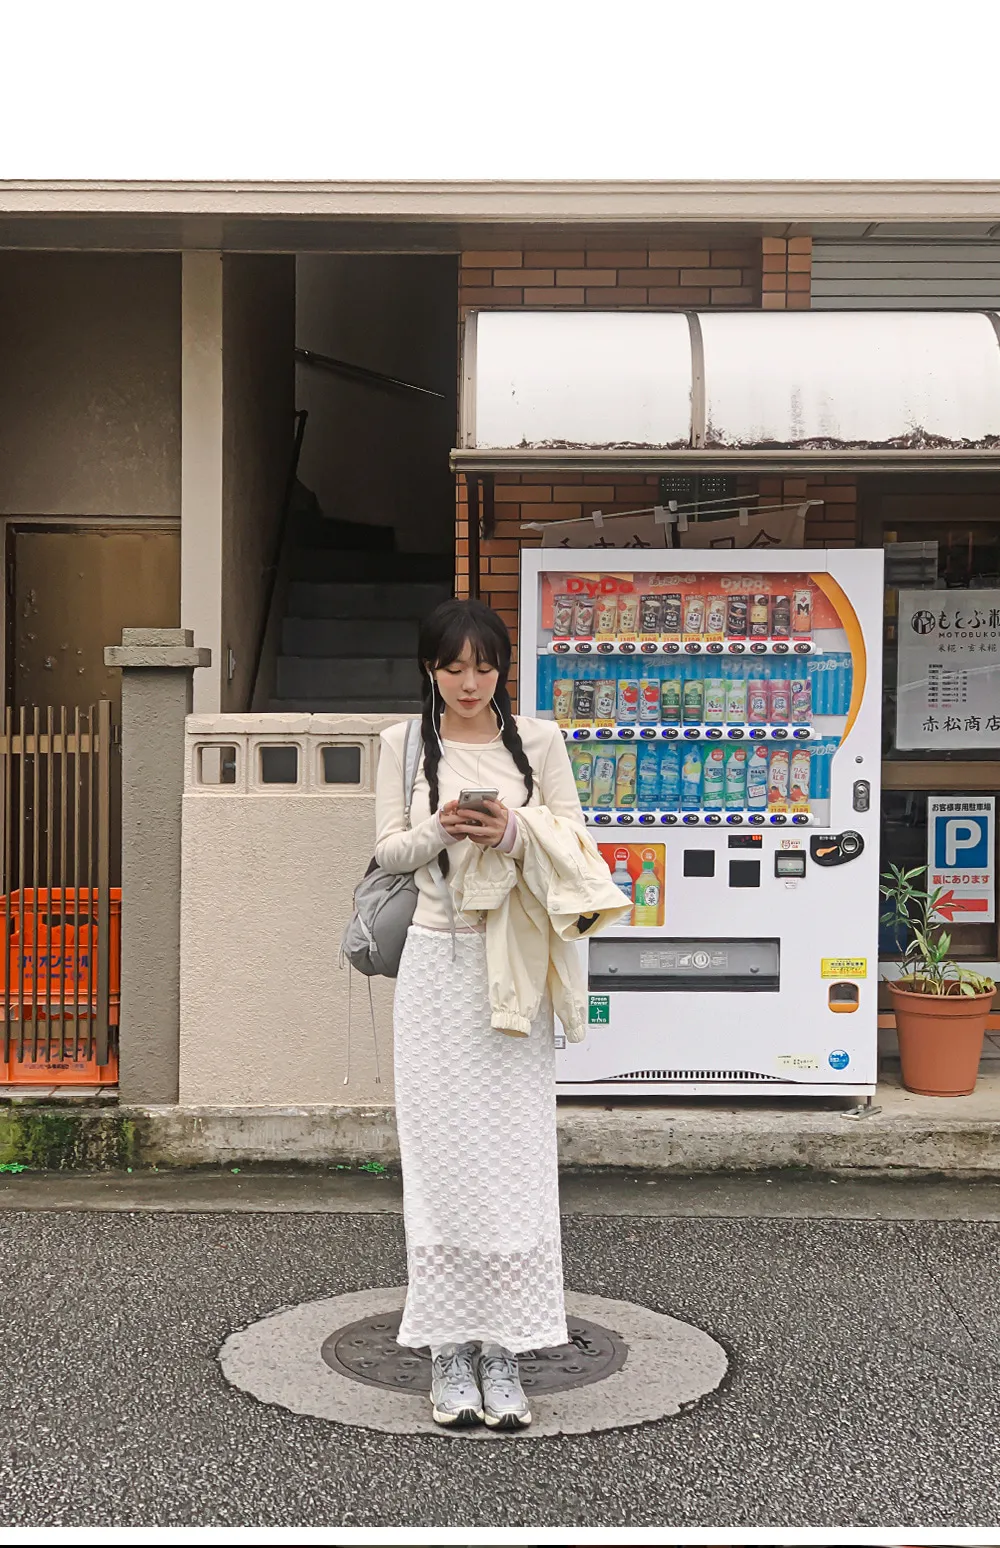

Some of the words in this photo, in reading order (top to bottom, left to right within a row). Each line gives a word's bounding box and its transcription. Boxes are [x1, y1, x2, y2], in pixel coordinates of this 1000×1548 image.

[566, 578, 634, 598] DyDo
[922, 715, 1000, 732] 赤松商店
[932, 803, 991, 812] お客様専用駐車場
[945, 819, 982, 866] P
[932, 874, 990, 884] 裏にあります
